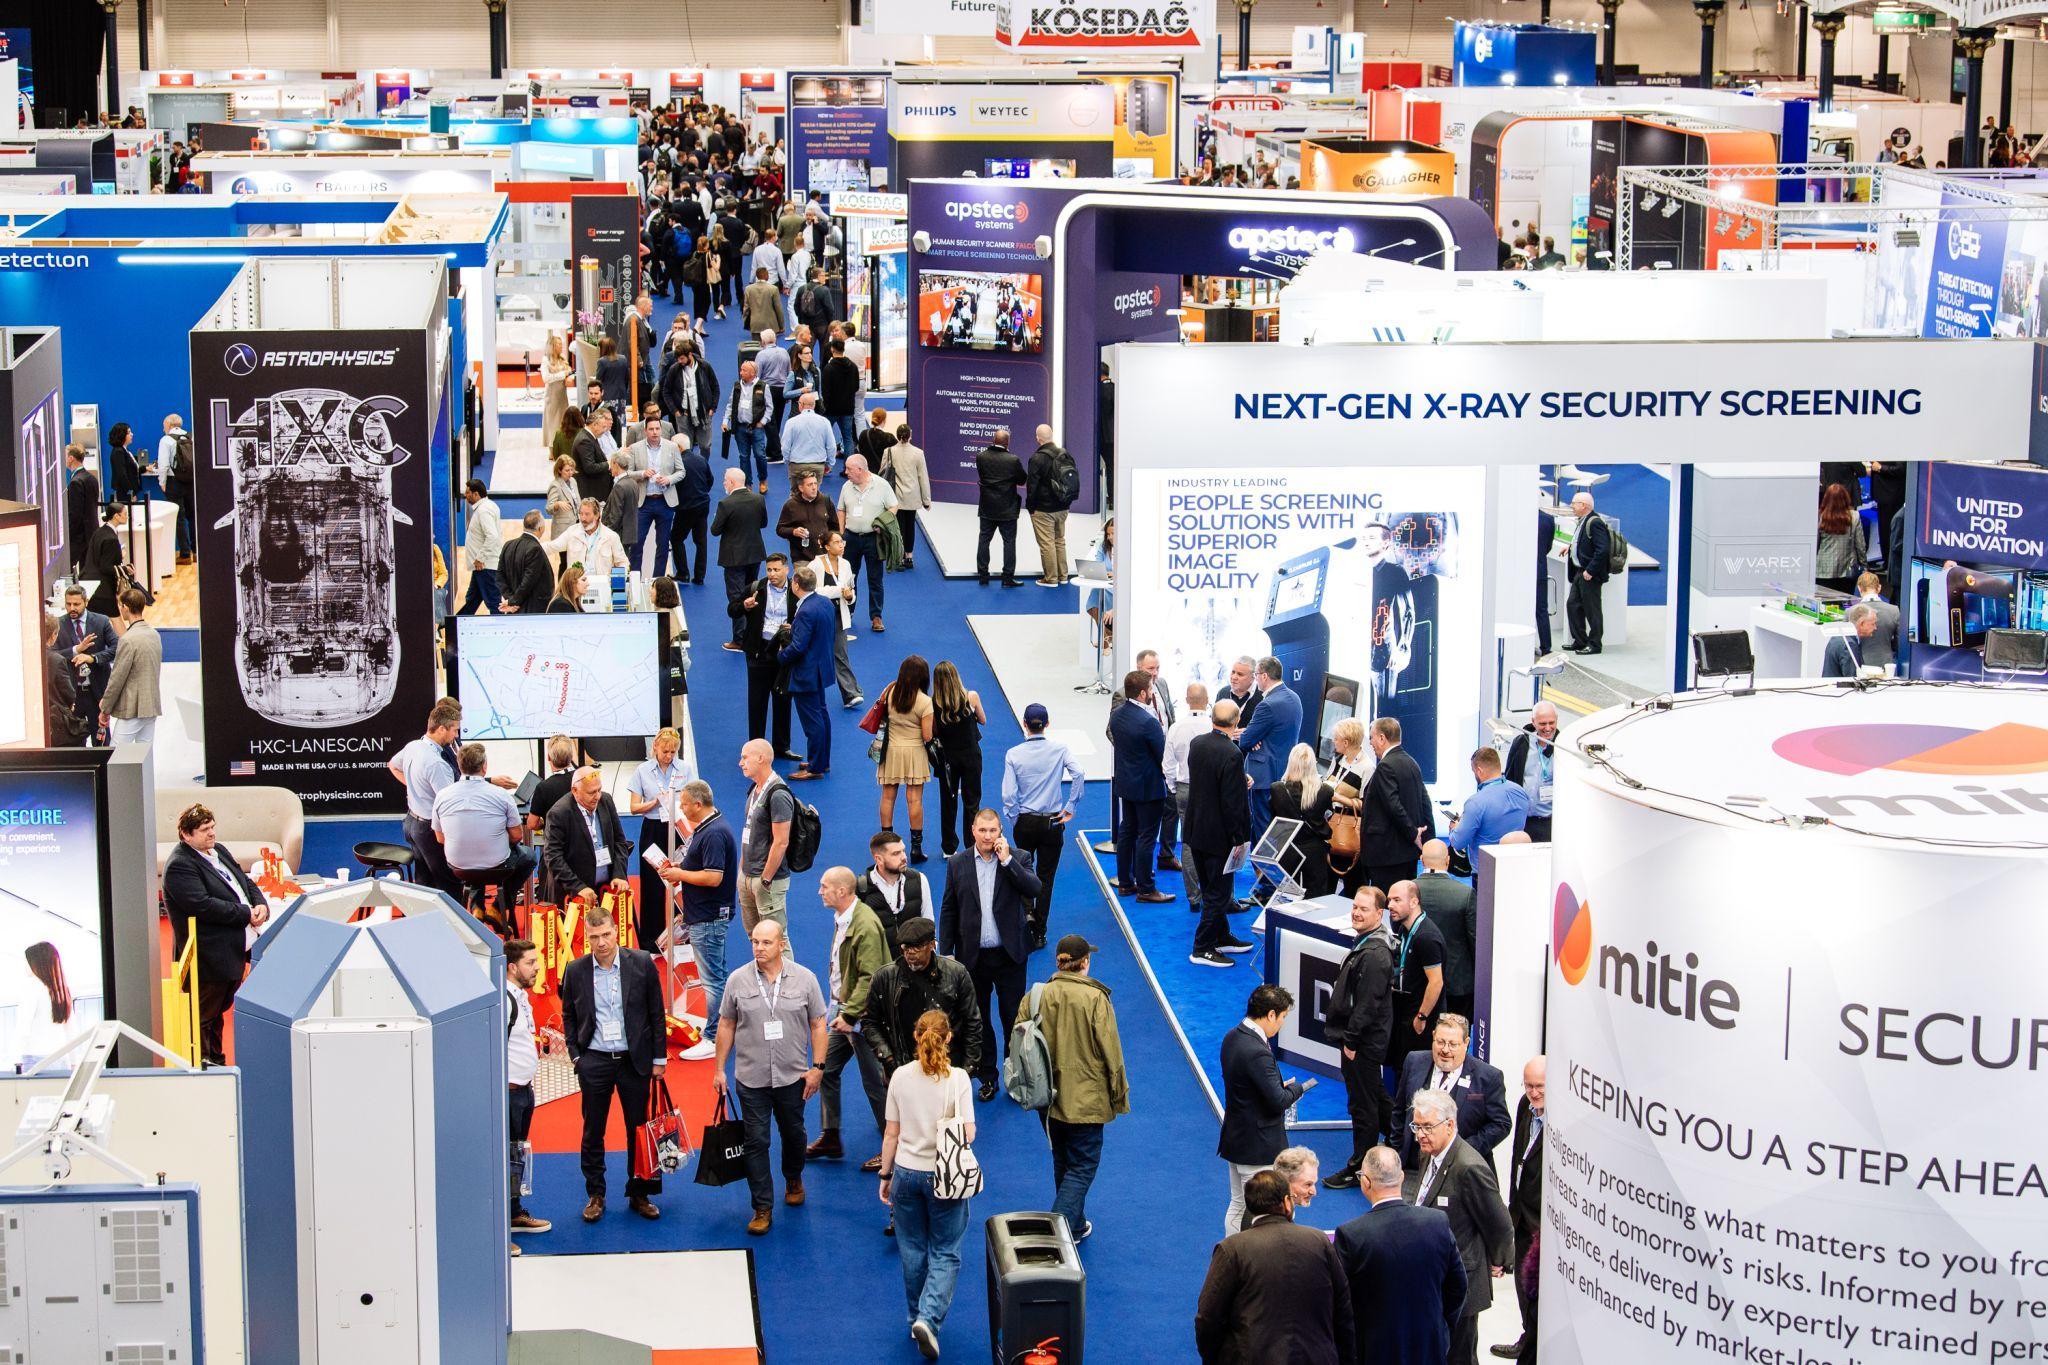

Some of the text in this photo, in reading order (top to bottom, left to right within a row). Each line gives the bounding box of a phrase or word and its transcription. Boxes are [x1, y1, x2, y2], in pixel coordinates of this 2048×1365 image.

[951, 0, 996, 12] Future
[904, 105, 957, 117] PHILIPS
[979, 106, 1029, 117] WEYTEC
[1366, 172, 1440, 187] GALLAGHER
[945, 201, 1015, 222] apstec
[975, 220, 1014, 230] systems
[956, 239, 984, 247] SECURITY
[986, 240, 1015, 249] SCANNER
[1229, 226, 1333, 254] apstec
[970, 251, 1005, 259] SCREENING
[1937, 270, 1994, 300] THREAT DETECTION
[1114, 288, 1153, 314] apstec
[1937, 287, 1965, 308] THROUGH
[1131, 308, 1153, 320] systems
[262, 350, 396, 367] ASTROPHYSICS
[960, 375, 1011, 384] HIGH-THROUGHPUT
[936, 389, 966, 398] AUTOMATIC
[967, 391, 995, 399] DETECTION
[1234, 388, 1922, 419] NEXT-GEN X-RAY SECURITY SCREENING
[210, 395, 411, 469] HXC
[1168, 477, 1287, 488] INDUSTRY LEADING
[1169, 493, 1383, 511] PEOPLE SCREENING
[1956, 496, 2023, 519] UNITED
[1168, 513, 1354, 531] SOLUTIONS WITH
[1970, 516, 2007, 536] FOR
[1168, 534, 1277, 550] SUPERIOR
[1933, 528, 2044, 557] INNOVATION
[1168, 553, 1237, 570] IMAGE
[1746, 557, 1802, 568] VAREX
[1168, 573, 1259, 592] QUALITY
[9, 832, 57, 842] convenient,
[16, 845, 61, 855] experience
[1599, 941, 1741, 1030] mitie
[1569, 1060, 1668, 1137] KEEPING
[1675, 1108, 1753, 1160] YOU
[1762, 1135, 1792, 1170] A
[1807, 1142, 1908, 1186] STEP
[1600, 1169, 1696, 1230] protecting
[1704, 1209, 1766, 1242] what
[1776, 1228, 1886, 1264] matters
[1899, 1246, 1930, 1271] to
[1942, 1253, 1997, 1279] you
[1549, 1166, 1578, 1208] threats
[1582, 1198, 1606, 1226] and
[1744, 1258, 1811, 1293] risks.
[1820, 1271, 1957, 1313] Informed
[1970, 1289, 2004, 1323] by
[1557, 1256, 1575, 1284] and
[1579, 1278, 1655, 1329] enhanced
[1664, 1311, 1687, 1347] by
[1609, 1250, 1698, 1305] delivered
[1708, 1285, 1735, 1321] by
[1744, 1303, 1860, 1349] expertly
[1871, 1325, 1977, 1357] trained
